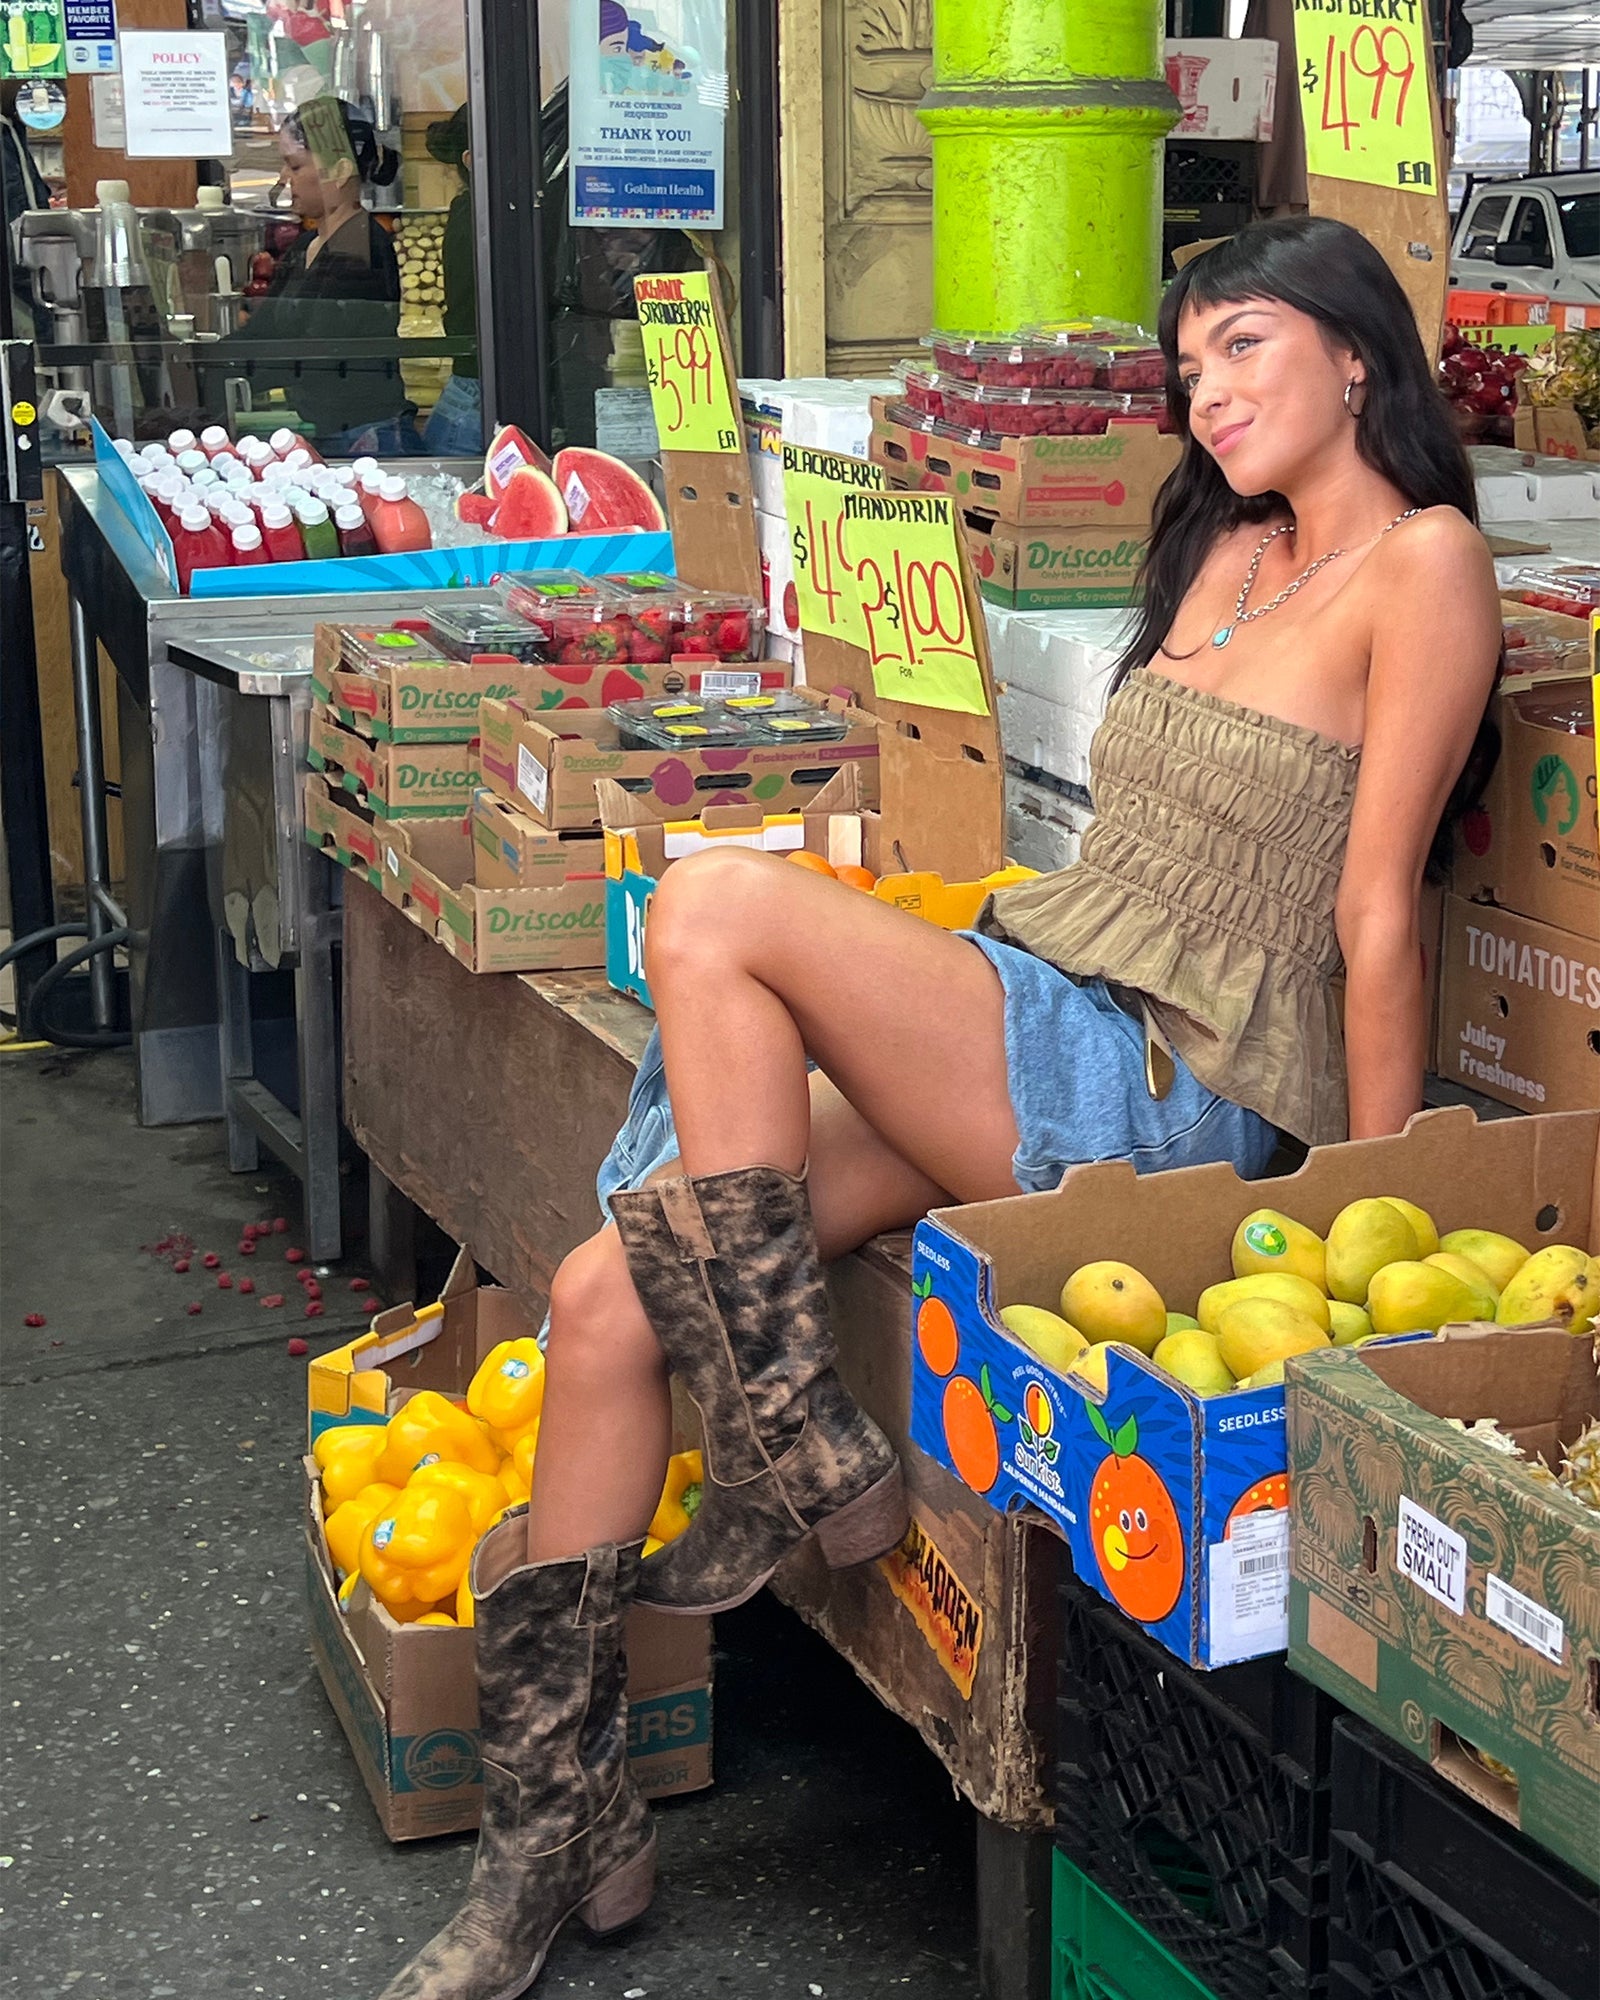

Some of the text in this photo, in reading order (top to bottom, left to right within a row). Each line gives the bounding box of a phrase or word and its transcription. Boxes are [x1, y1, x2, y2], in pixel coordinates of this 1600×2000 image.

[67, 6, 110, 15] MEMBER
[68, 15, 111, 24] FAVORITE
[152, 53, 201, 64] POLICY
[609, 101, 682, 111] FACE COVERINGS
[624, 111, 668, 120] REQUIRED
[600, 127, 692, 142] THANK YOU!
[1397, 161, 1433, 186] EA
[624, 182, 705, 196] Gotham Health
[636, 279, 686, 301] ORGANIC
[640, 301, 712, 328] STRAWBERRY
[718, 429, 737, 450] EA
[1033, 437, 1128, 458] Driscoll's
[1546, 437, 1579, 459] Dole
[783, 446, 884, 491] BLACKBERRY
[844, 494, 949, 525] MANDARIN
[1029, 591, 1129, 605] Organic Strawberr
[899, 666, 915, 680] FOR
[397, 764, 481, 789] Drisco
[487, 902, 605, 934] Driscoll
[1466, 925, 1600, 1010] TOMATOES
[1460, 1021, 1506, 1060] Juicy
[1459, 1049, 1546, 1103] Freshness
[917, 1240, 951, 1272] SEEDLESS
[1218, 1406, 1287, 1433] SEEDLESS
[1016, 1443, 1062, 1497] Sunkist
[1003, 1461, 1078, 1525] CALIFORNIA MANDARINS
[1403, 1543, 1456, 1602] SMALL
[1438, 1607, 1512, 1661] PINEAPPLE
